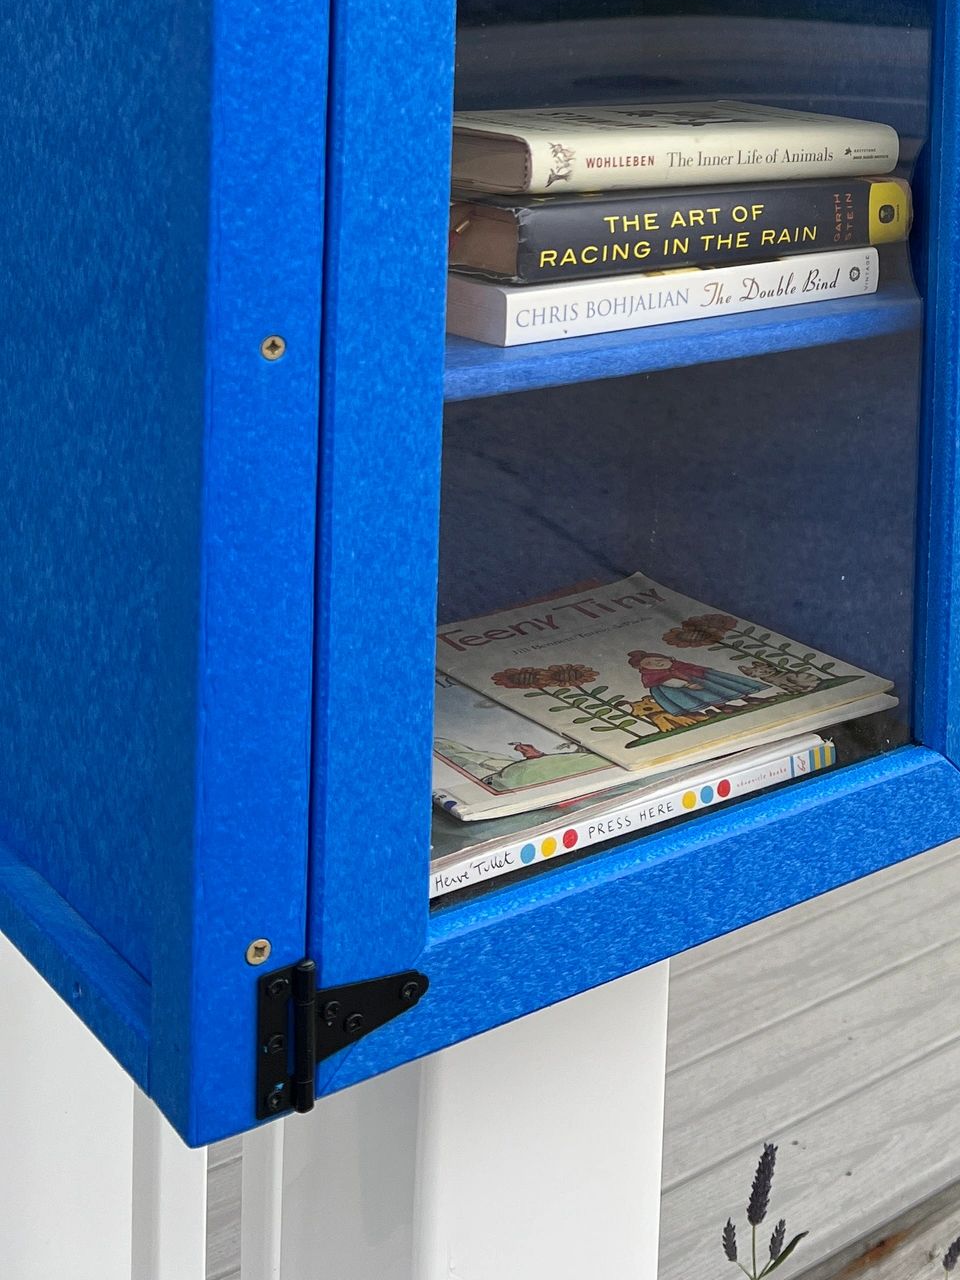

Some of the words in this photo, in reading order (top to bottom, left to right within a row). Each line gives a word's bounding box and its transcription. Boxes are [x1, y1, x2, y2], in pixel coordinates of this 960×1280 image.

[586, 155, 655, 168] WOHLLEBEN
[667, 152, 695, 169] The
[698, 151, 734, 167] Inner
[736, 149, 764, 166] Life
[766, 148, 778, 164] of
[781, 147, 834, 163] Animals
[604, 214, 660, 234] THE
[670, 210, 722, 228] ART
[732, 204, 764, 223] OF
[834, 193, 842, 242] GARTH
[845, 193, 853, 240] STEIN
[538, 242, 651, 268] RACING
[662, 239, 689, 256] IN
[699, 233, 751, 253] THE
[760, 225, 818, 245] RAIN
[515, 306, 580, 329] CHRIS
[585, 287, 690, 320] BOHJALIAN
[700, 280, 733, 310] The
[738, 270, 798, 304] Double
[802, 267, 841, 295] Bind
[437, 614, 560, 652] Teeny
[552, 587, 667, 619] Tiny
[588, 815, 632, 839] PRESS
[640, 802, 675, 822] HERE
